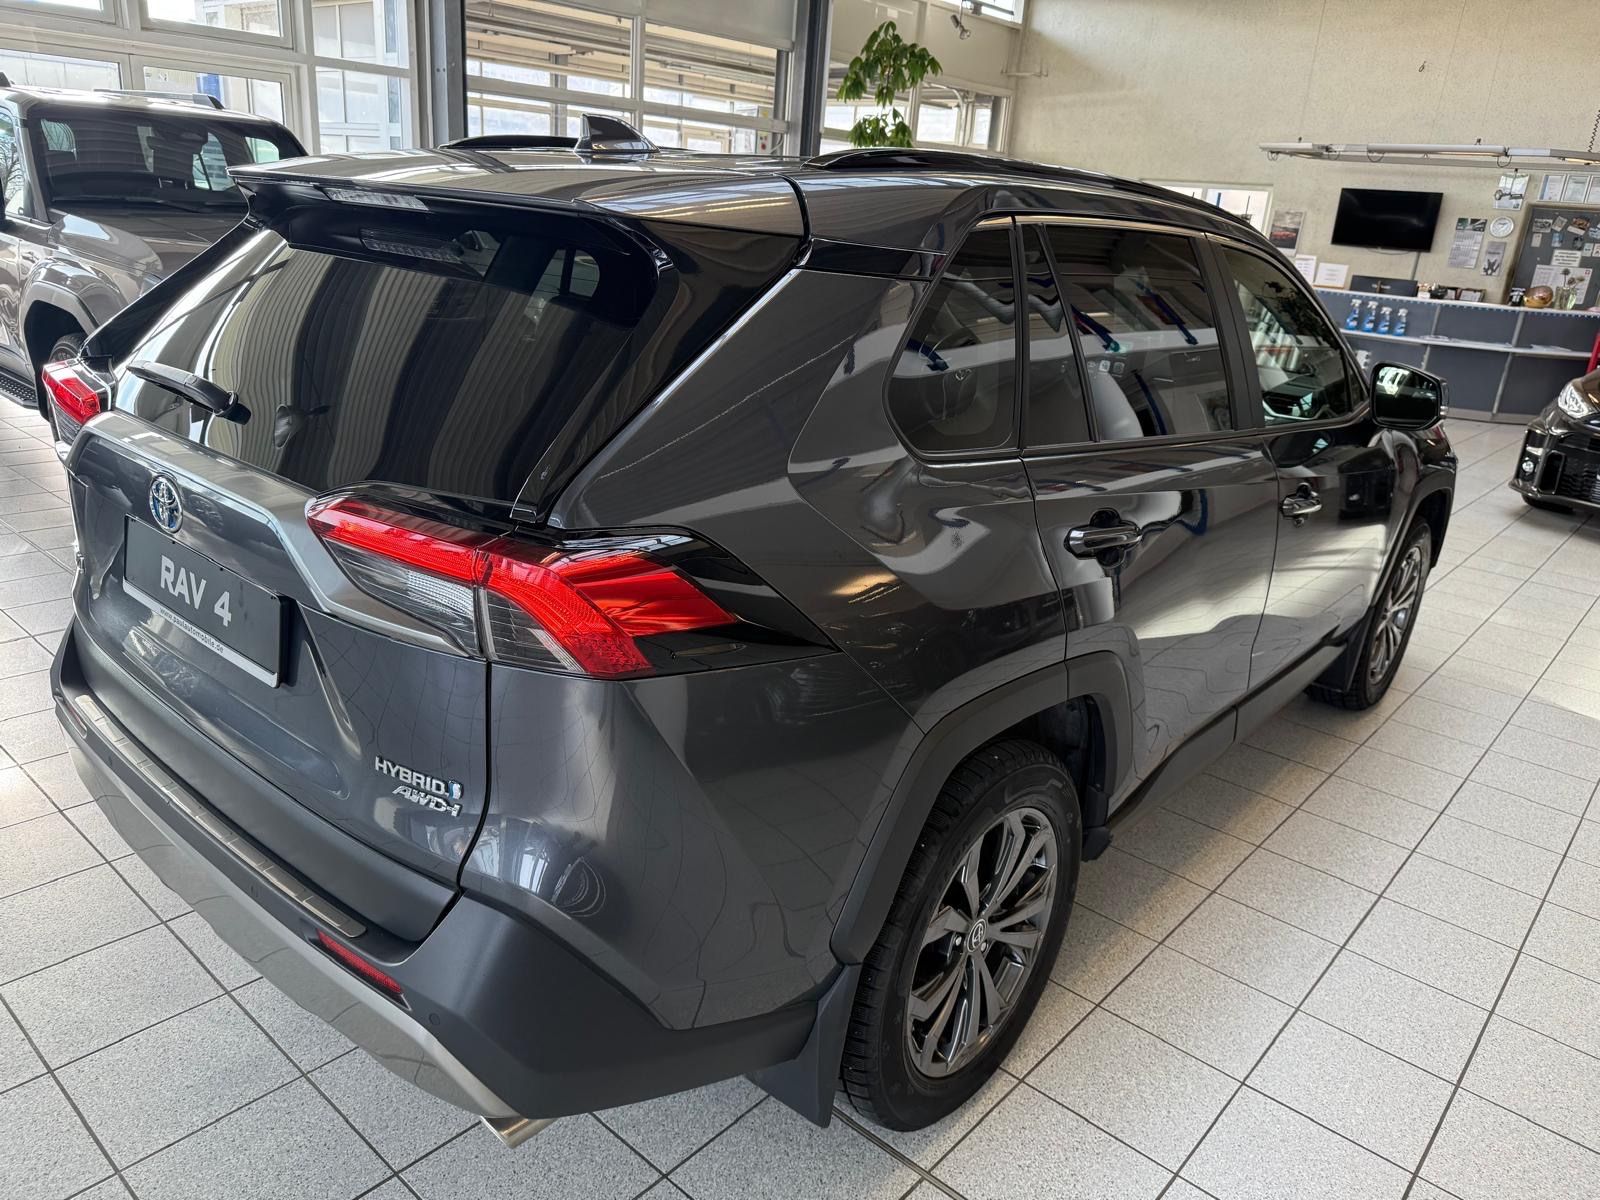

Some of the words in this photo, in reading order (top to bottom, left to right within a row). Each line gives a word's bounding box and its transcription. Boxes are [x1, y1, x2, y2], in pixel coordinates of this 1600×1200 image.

[160, 555, 207, 610] RAV
[214, 591, 232, 627] 4
[375, 756, 445, 795] HYBRID
